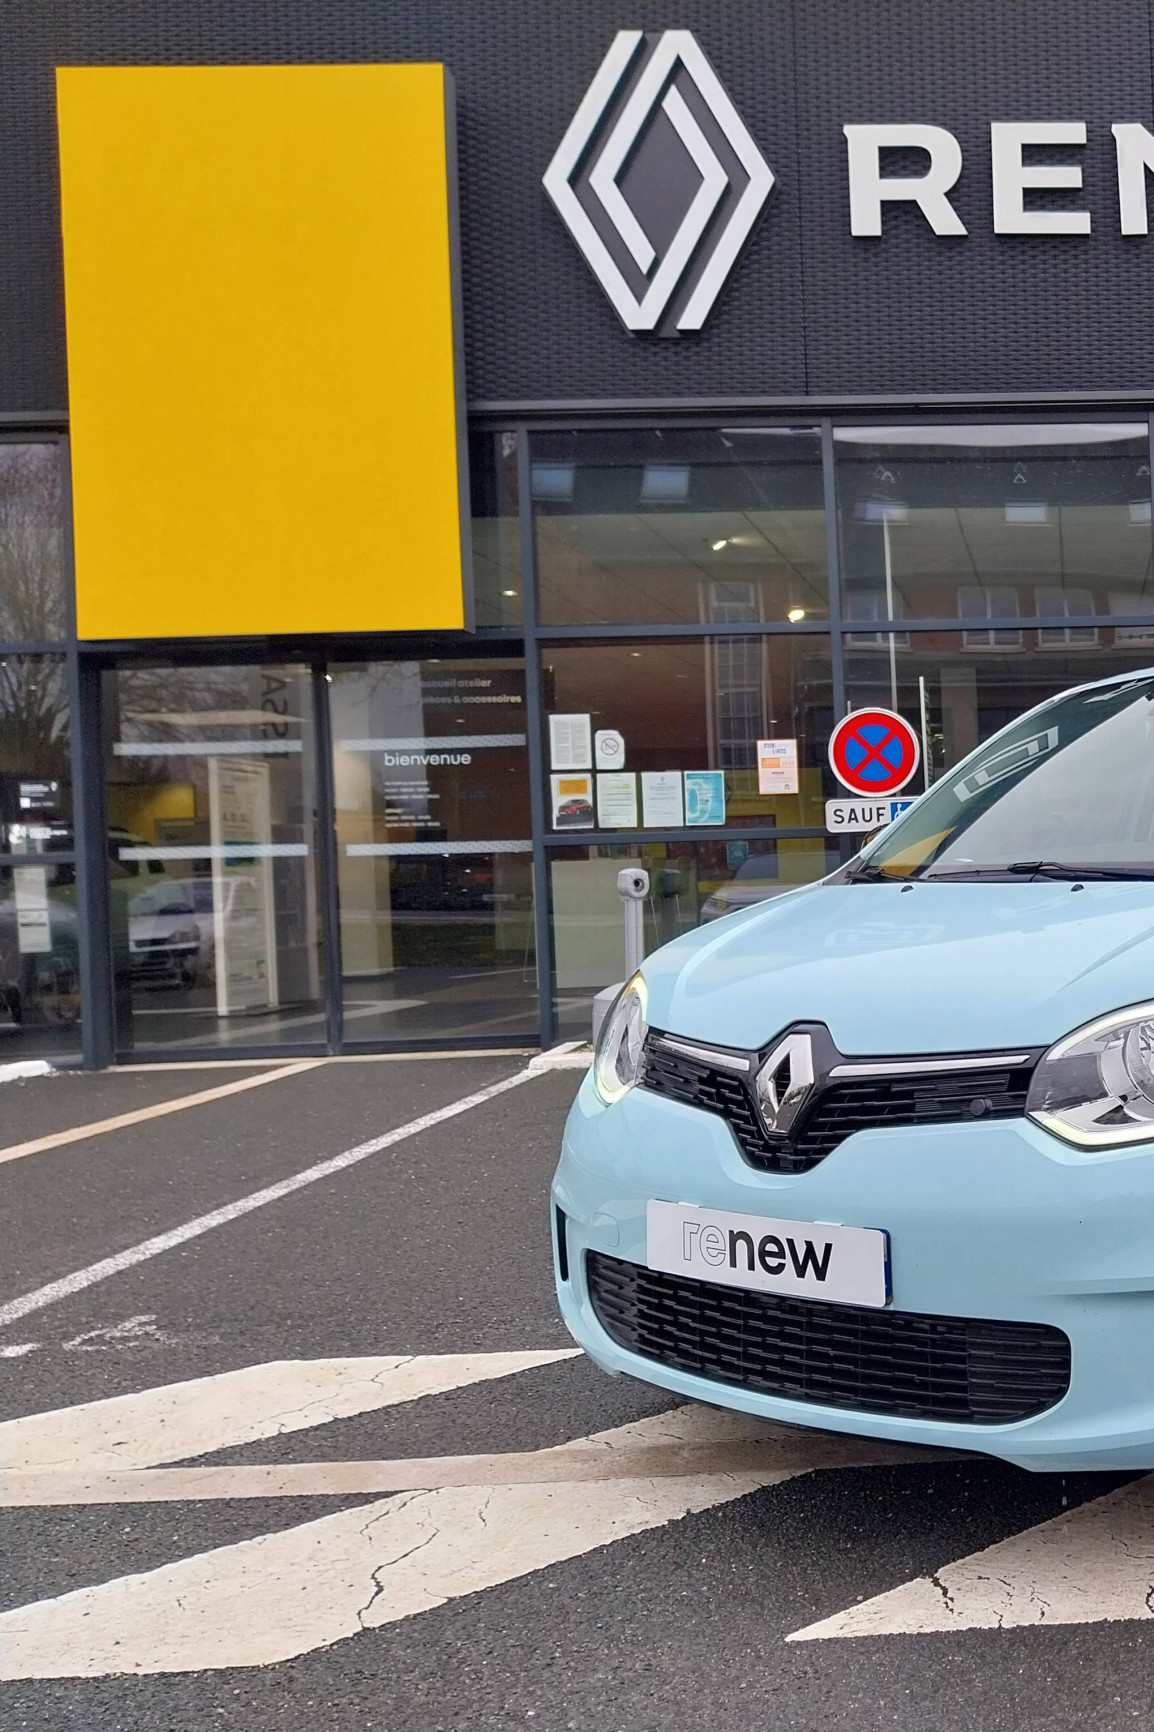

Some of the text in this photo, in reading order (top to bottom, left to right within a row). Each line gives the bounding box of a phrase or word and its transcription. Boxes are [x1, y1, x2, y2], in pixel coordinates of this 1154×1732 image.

[457, 678, 492, 688] atelier
[453, 695, 462, 704] &
[462, 694, 522, 703] accessoires
[384, 752, 472, 767] bienvenue
[833, 806, 886, 825] SAUF
[682, 1220, 833, 1282] renew
